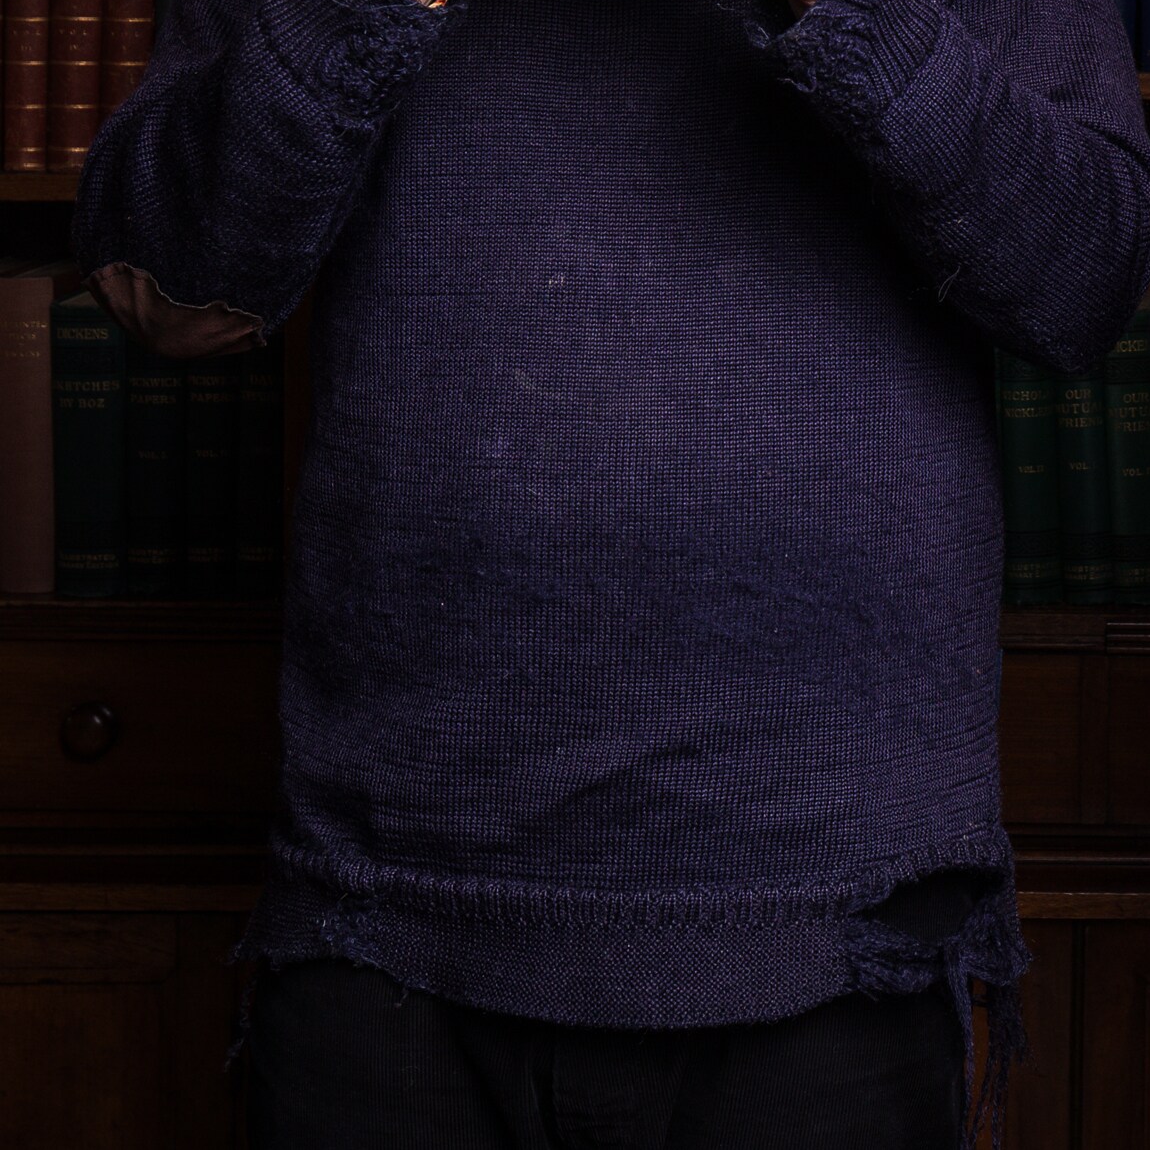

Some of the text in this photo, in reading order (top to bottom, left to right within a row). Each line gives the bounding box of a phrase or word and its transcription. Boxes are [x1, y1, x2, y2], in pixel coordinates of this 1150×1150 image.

[57, 327, 109, 340] DICKENS
[1065, 389, 1092, 400] OUR
[1122, 393, 1150, 403] OUR
